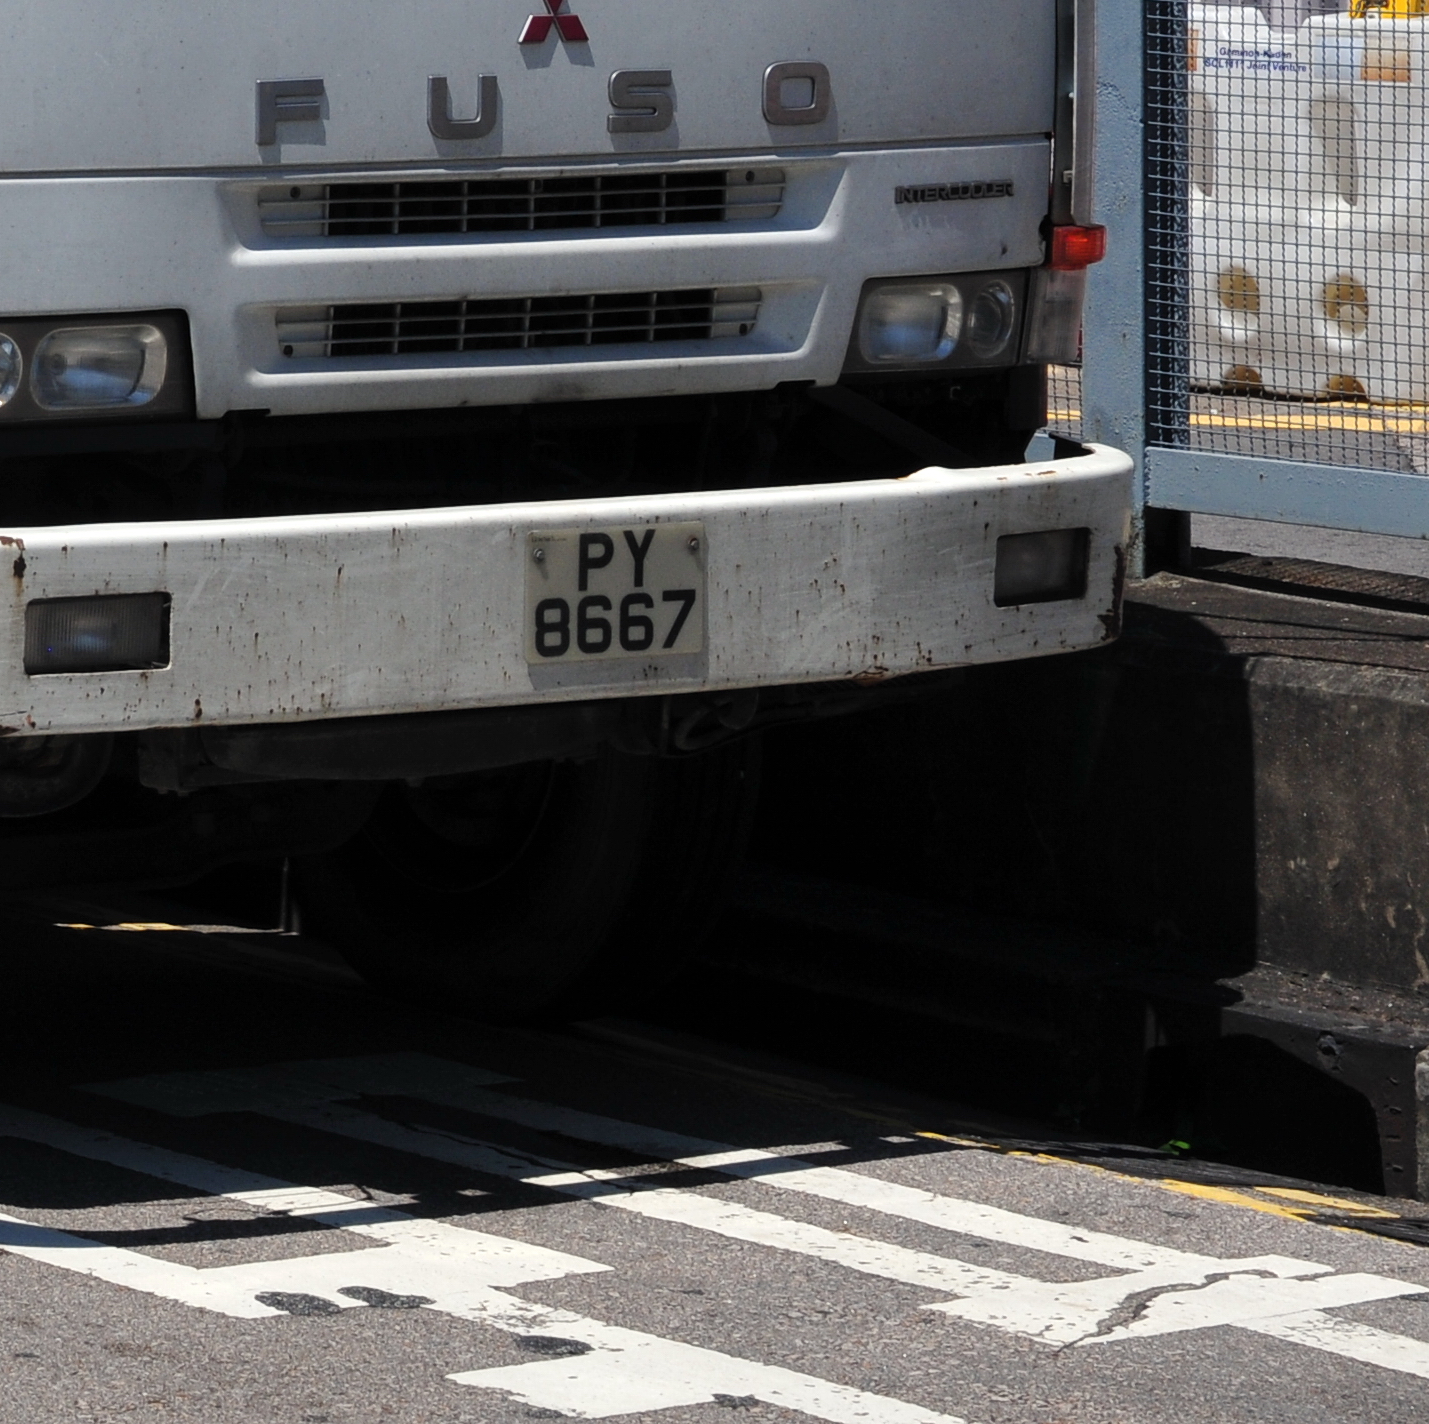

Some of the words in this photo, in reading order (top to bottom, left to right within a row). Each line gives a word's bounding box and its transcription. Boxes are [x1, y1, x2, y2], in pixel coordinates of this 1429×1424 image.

[255, 60, 831, 146] FUSO
[894, 179, 1015, 205] INTERCOOLER
[578, 528, 656, 592] PY
[534, 588, 697, 658] 8667
